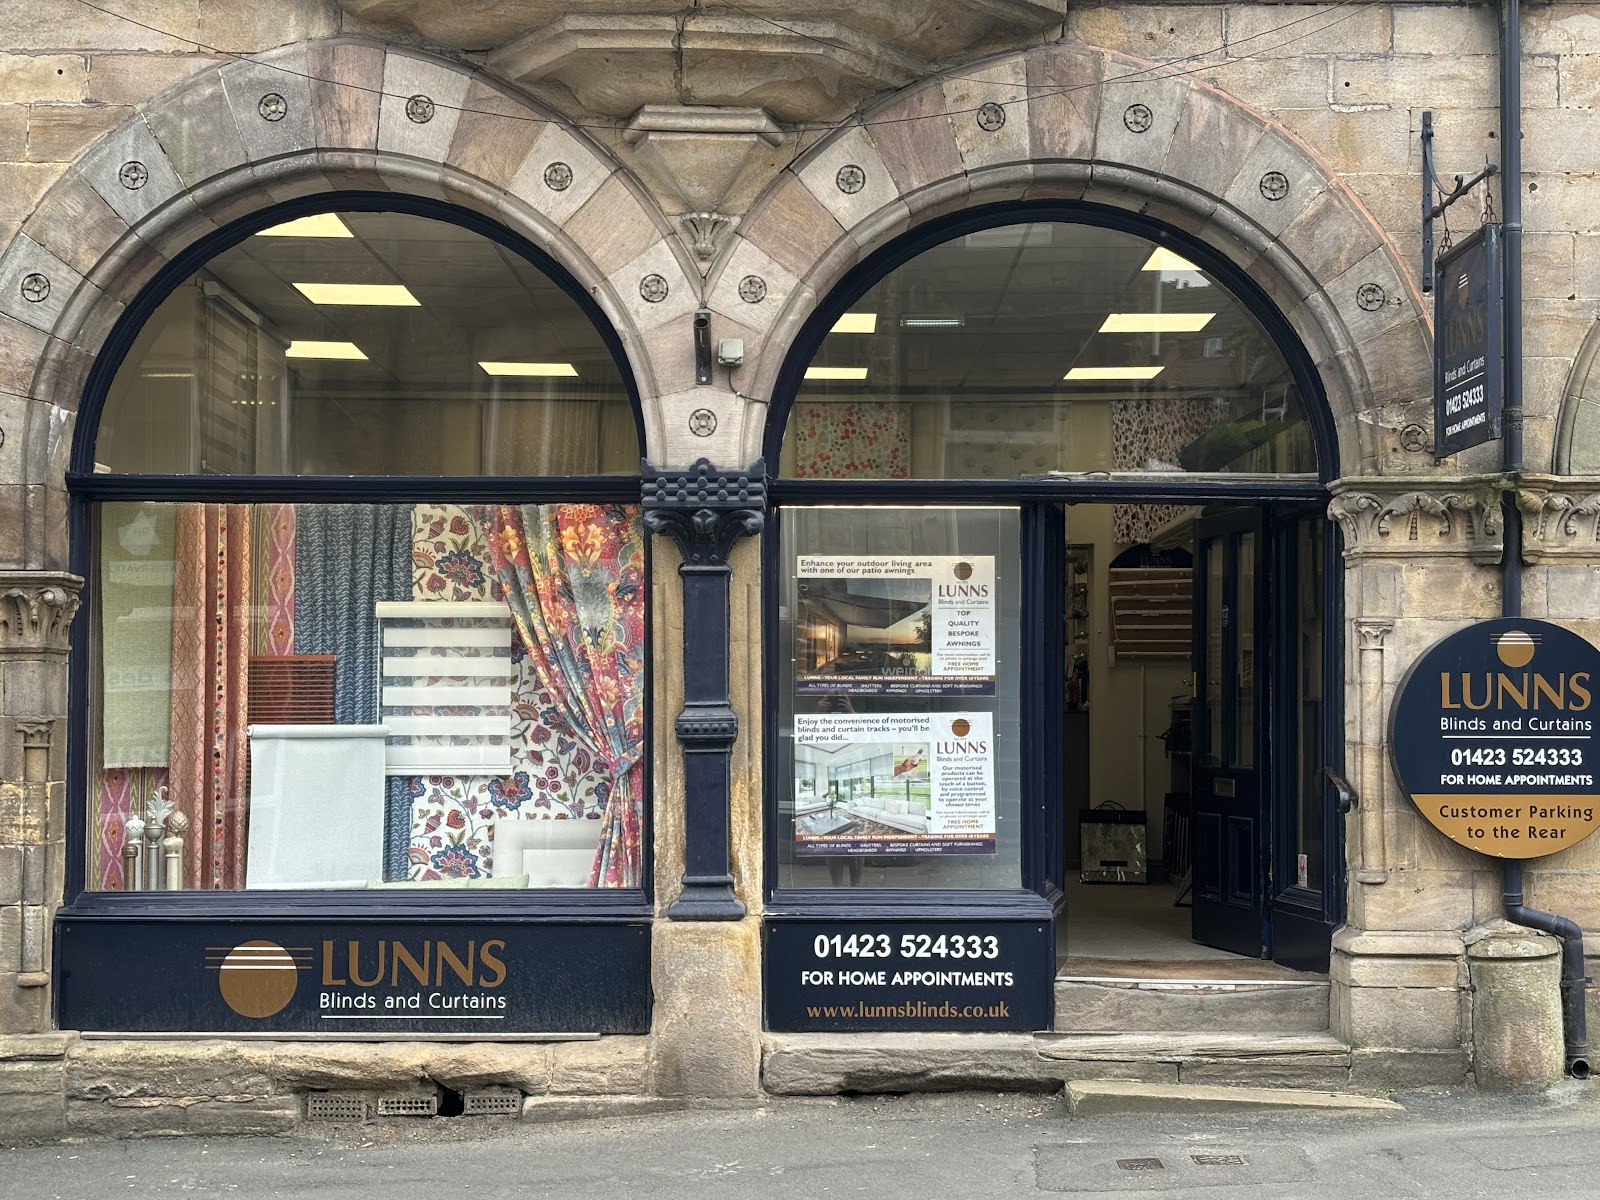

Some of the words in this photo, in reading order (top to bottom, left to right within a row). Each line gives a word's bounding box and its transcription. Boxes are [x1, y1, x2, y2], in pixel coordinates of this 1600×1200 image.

[1445, 304, 1484, 358] LUNNS
[1445, 368, 1457, 384] Blinds
[1467, 355, 1484, 372] Curtains
[1446, 394, 1461, 416] 01423
[1462, 384, 1484, 409] 524333
[1452, 422, 1461, 433] HOME
[1461, 412, 1485, 430] APPOINTMENTS
[938, 585, 988, 597] LUNNS
[1441, 672, 1592, 711] LUNNS
[1440, 718, 1486, 731] Blinds
[1493, 718, 1522, 730] and
[1528, 718, 1592, 731] Curtains
[937, 741, 986, 754] LUNNS
[1452, 749, 1506, 765] 01423
[1512, 749, 1583, 766] 524333
[1441, 775, 1464, 785] FOR
[1467, 775, 1502, 785] HOME
[1505, 775, 1593, 786] APPOINTMENTS
[1440, 805, 1521, 818] Customer
[1529, 805, 1593, 821] Parking
[1467, 826, 1485, 839] to
[1493, 826, 1520, 839] the
[1528, 826, 1567, 839] Rear
[814, 934, 891, 958] 01423
[900, 934, 999, 959] 524333
[322, 939, 507, 988] LUNNS
[802, 971, 833, 985] FOR
[838, 971, 886, 986] HOME
[891, 972, 1014, 987] APPOINTMENTS
[320, 993, 376, 1008] Blinds
[385, 993, 420, 1008] and
[428, 993, 506, 1009] Curtains
[807, 1001, 1010, 1018] www.lunnsblinds.co.uk
